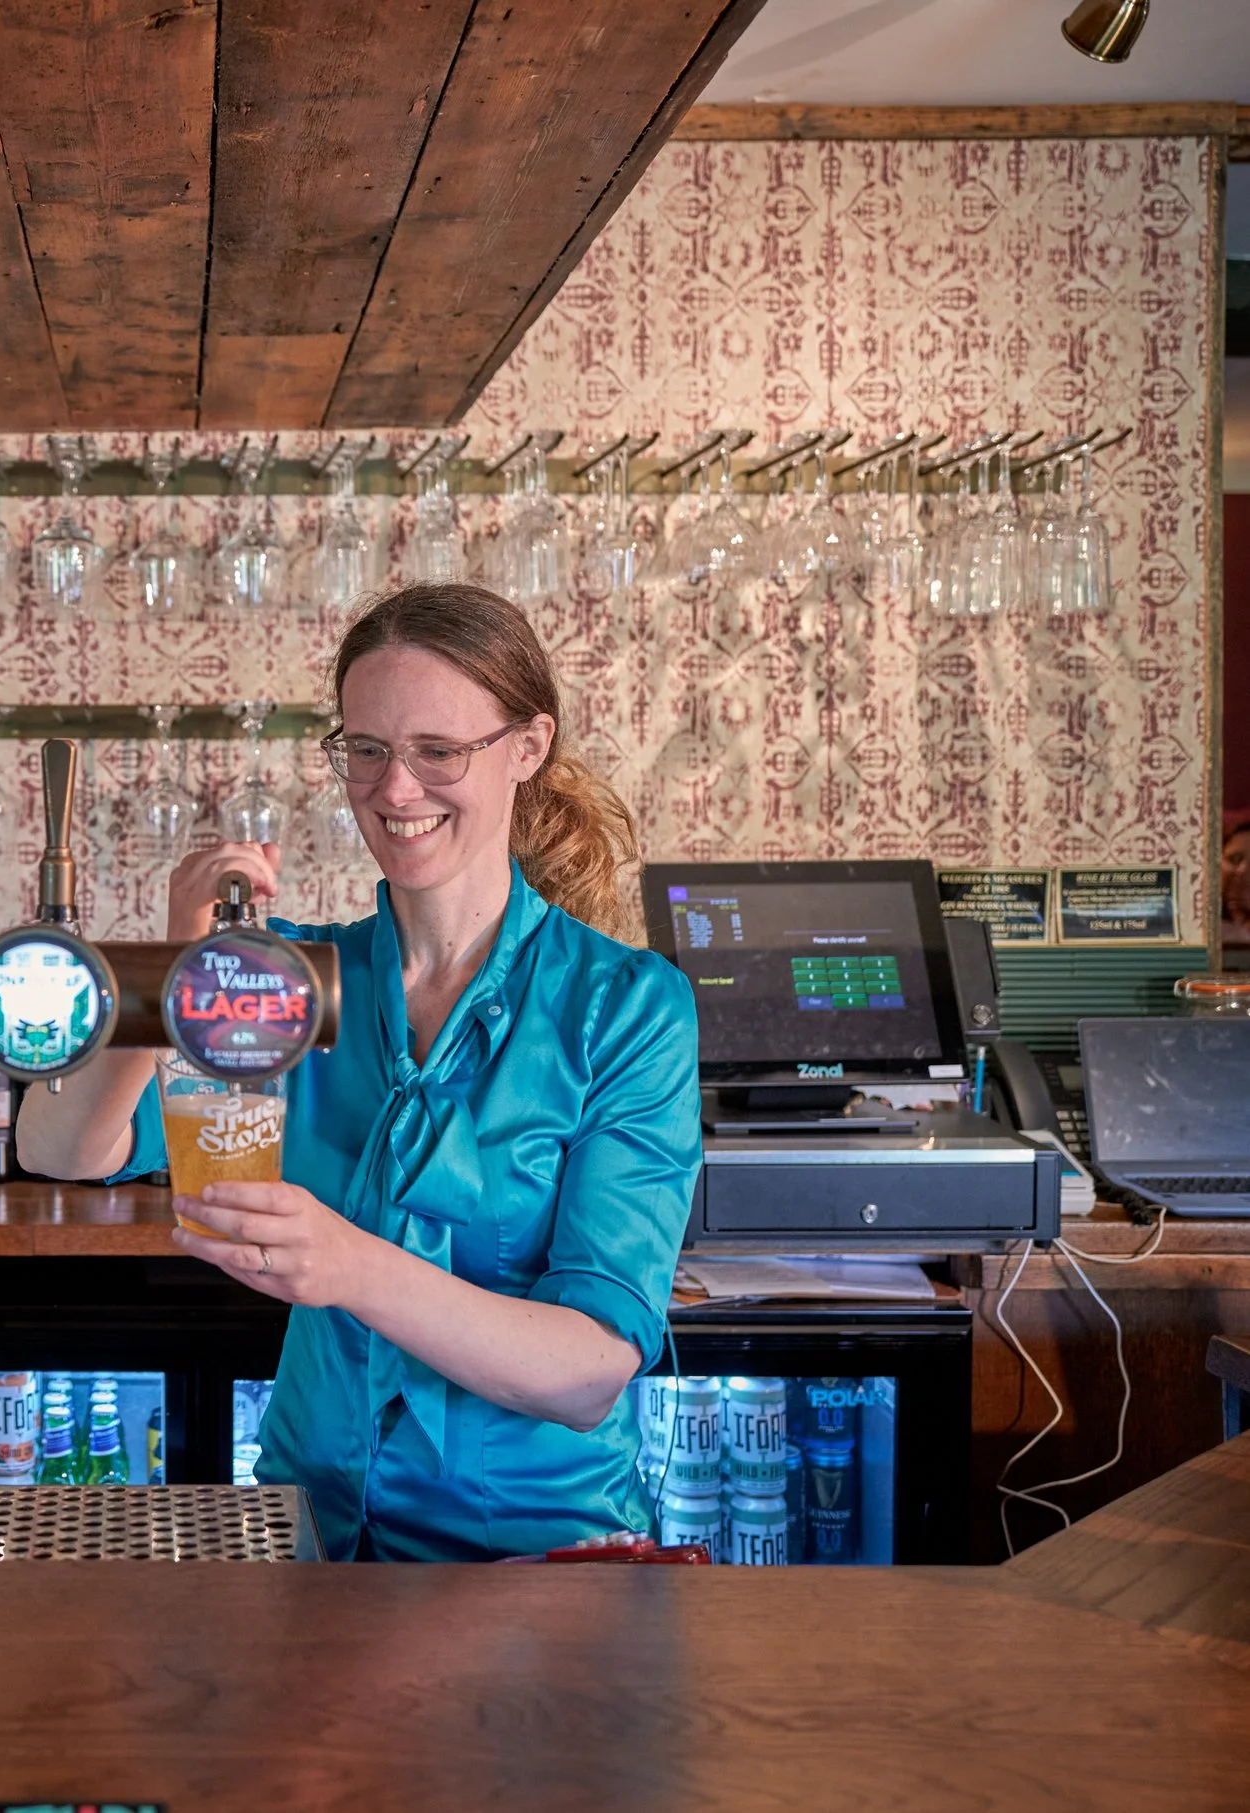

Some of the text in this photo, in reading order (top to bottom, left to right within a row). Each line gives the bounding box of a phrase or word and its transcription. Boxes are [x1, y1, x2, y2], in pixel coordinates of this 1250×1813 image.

[181, 985, 307, 1021] LAGER
[797, 1062, 844, 1079] Zonal
[203, 1098, 276, 1134] True
[197, 1117, 281, 1153] Story
[810, 1387, 887, 1408] POLAR
[675, 1464, 699, 1480] WILD
[735, 1463, 757, 1479] WILD
